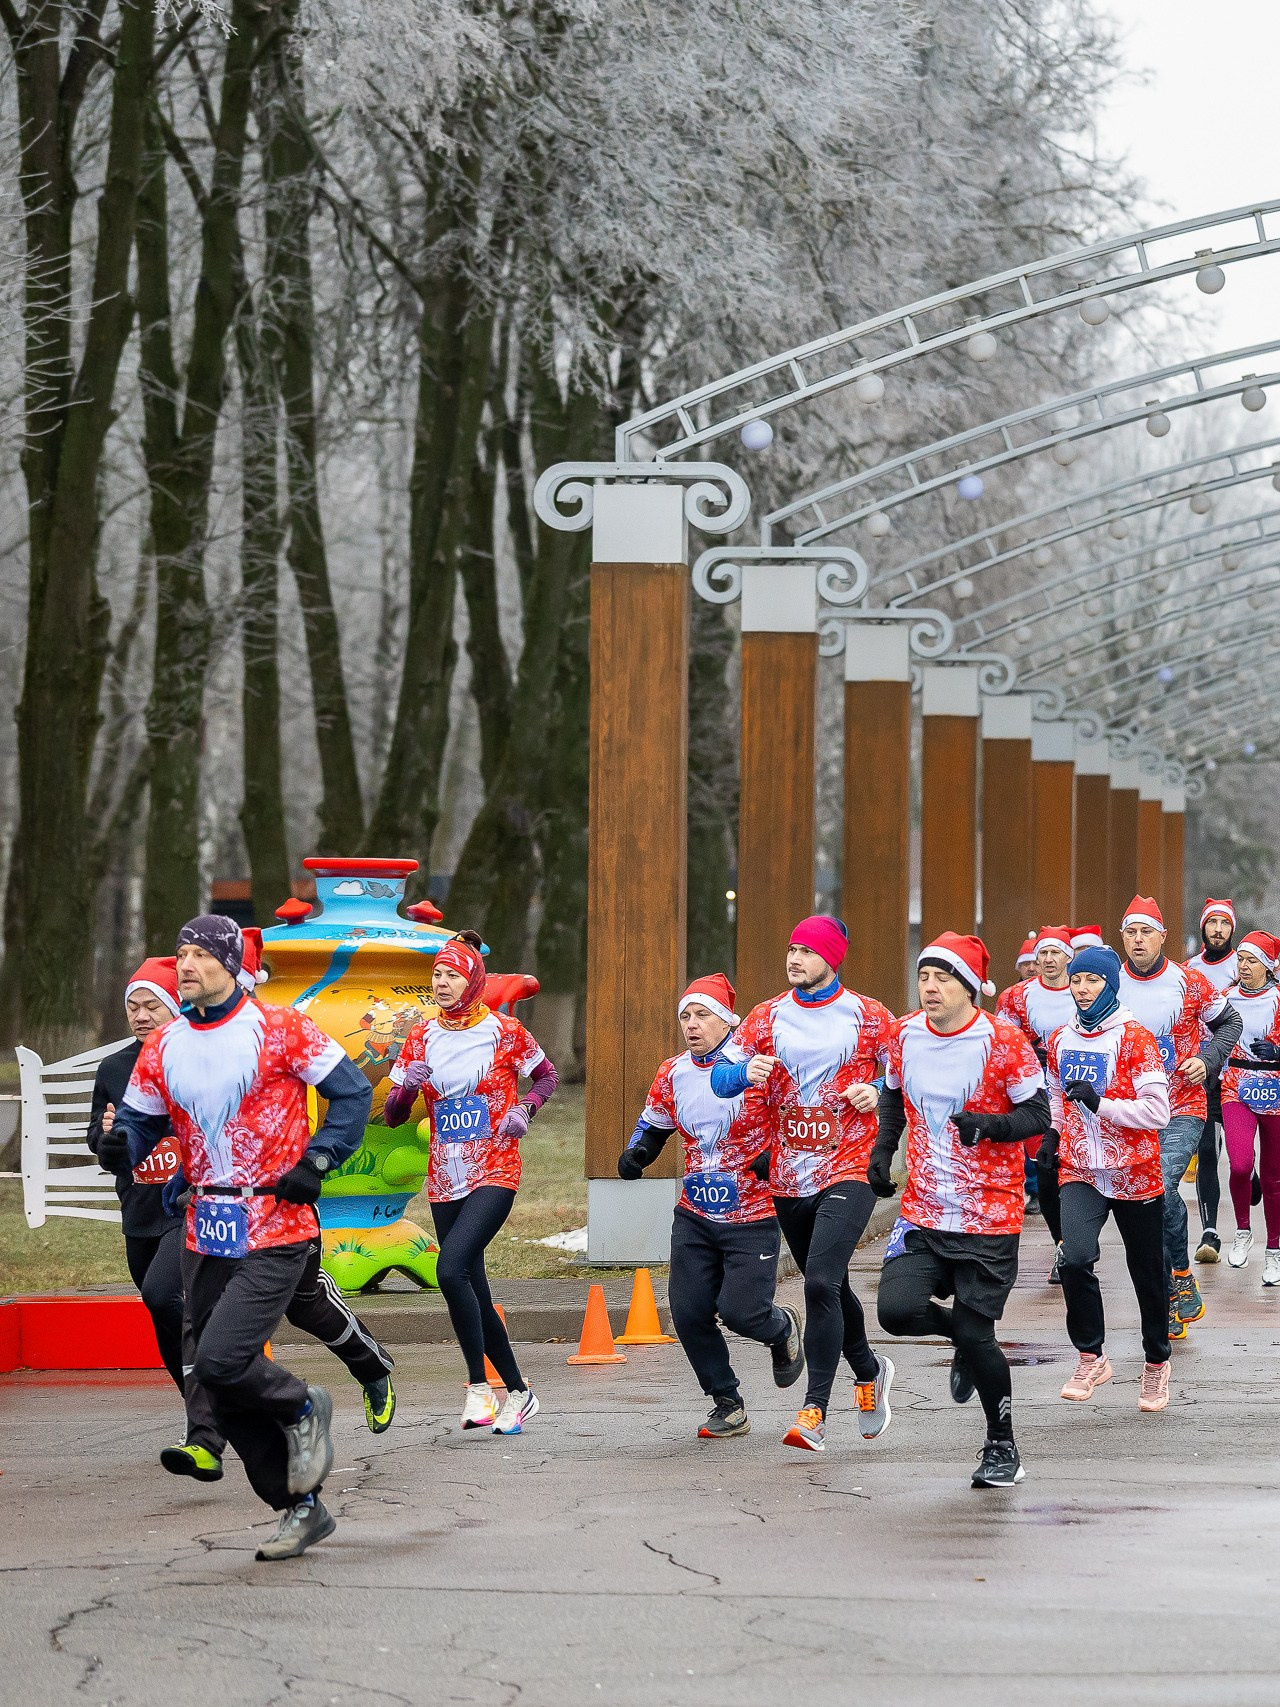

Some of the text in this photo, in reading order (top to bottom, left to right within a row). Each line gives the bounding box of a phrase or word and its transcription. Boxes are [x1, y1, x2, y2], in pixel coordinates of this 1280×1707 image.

[1064, 1063, 1098, 1083] 2175
[1242, 1087, 1278, 1101] 2085
[440, 1109, 481, 1132] 2007
[787, 1120, 831, 1140] 5019
[691, 1185, 731, 1203] 2102
[198, 1217, 237, 1242] 2401
